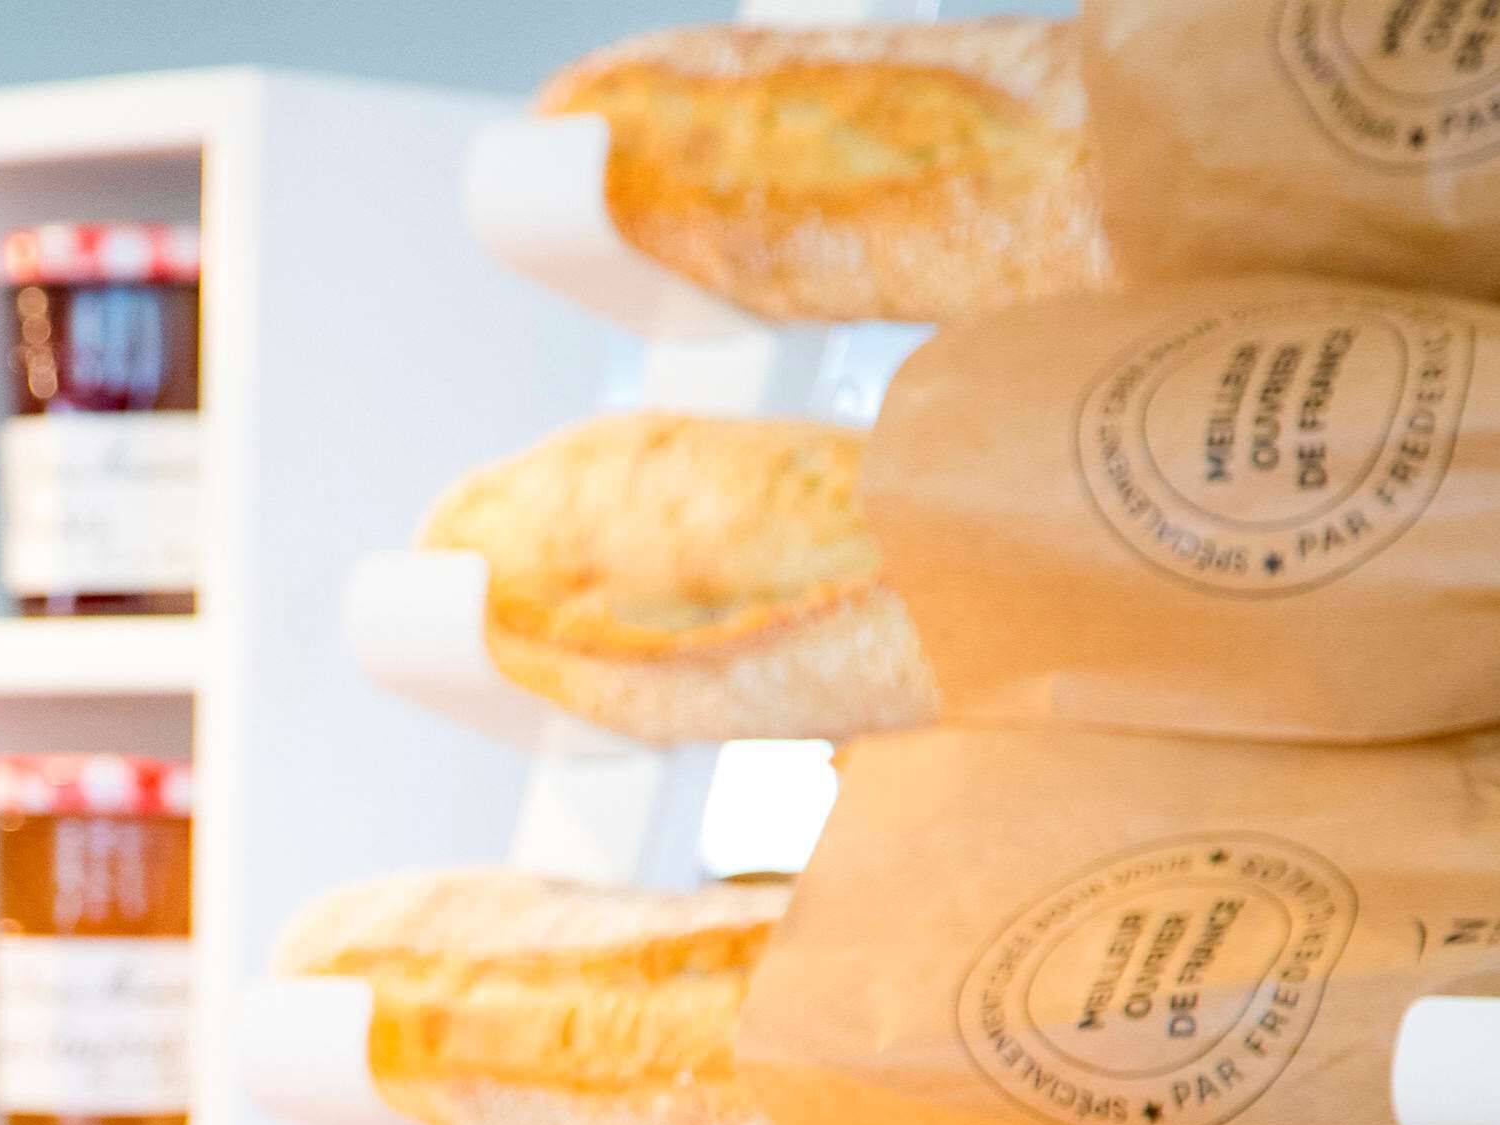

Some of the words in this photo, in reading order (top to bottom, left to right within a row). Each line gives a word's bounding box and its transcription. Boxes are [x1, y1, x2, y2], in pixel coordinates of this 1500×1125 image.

[1298, 447, 1328, 490] DE
[1299, 510, 1374, 558] PAR
[1169, 992, 1198, 1038] DE
[1171, 1056, 1244, 1110] PAR
